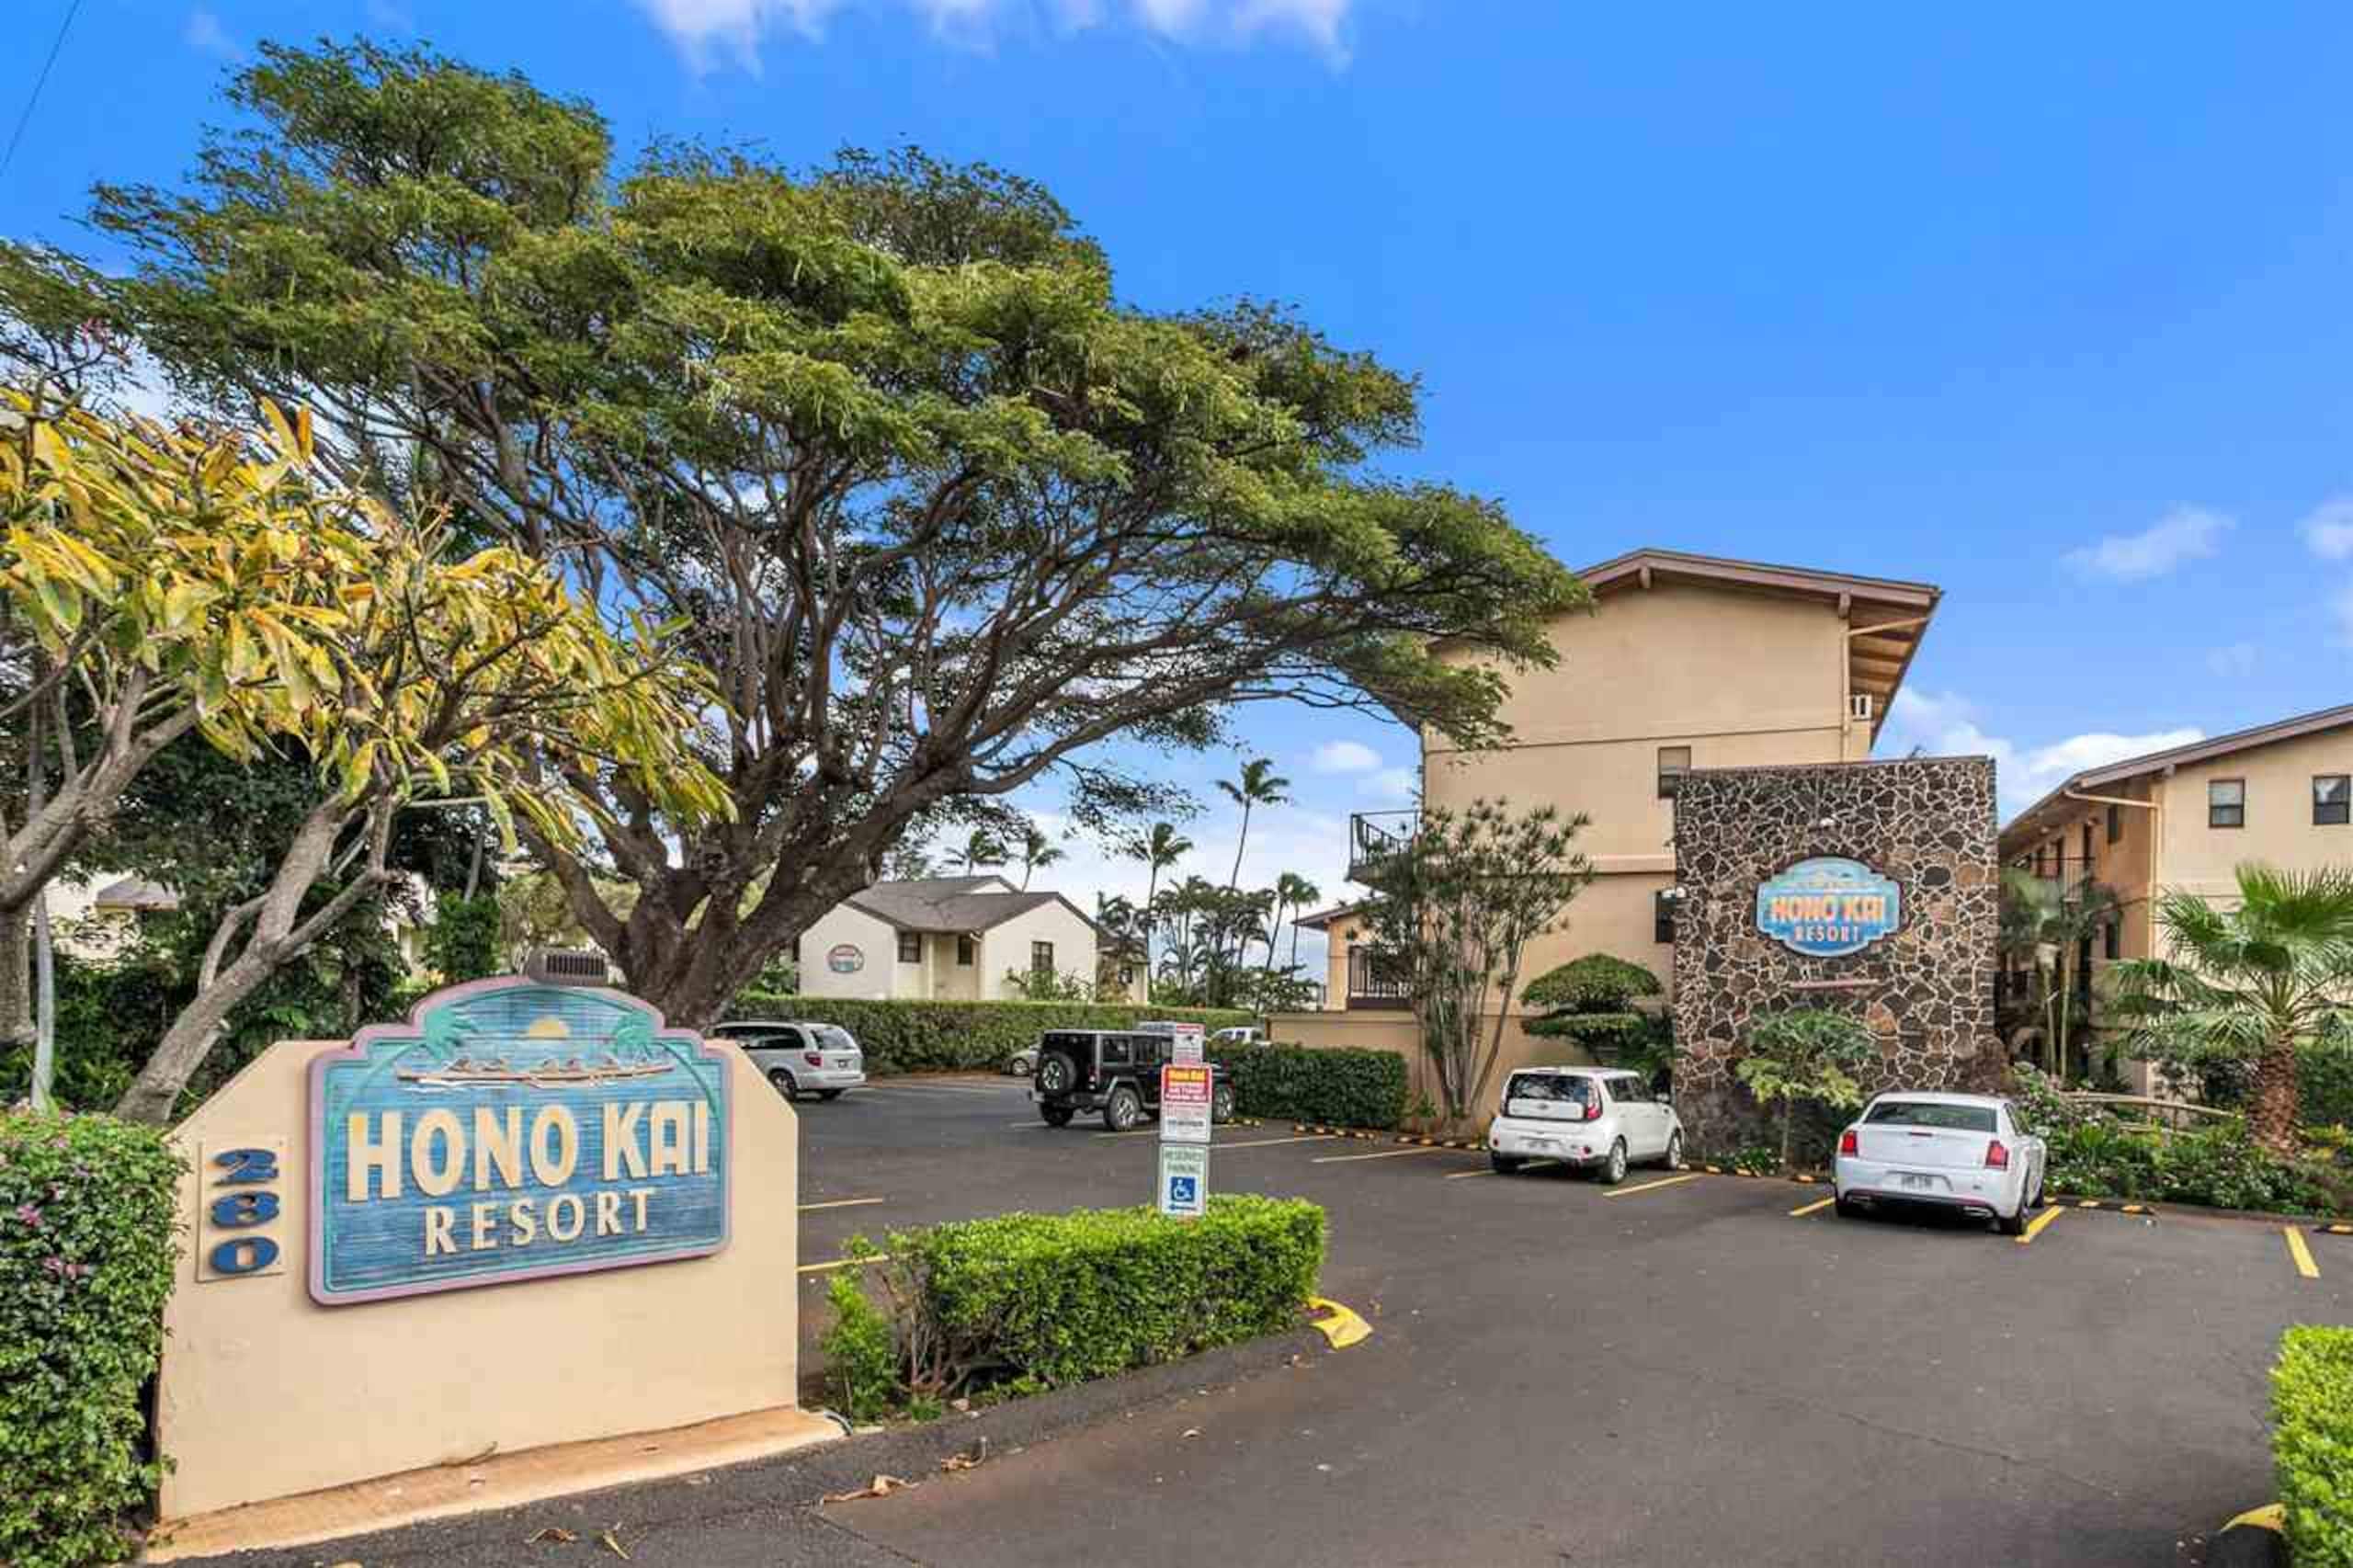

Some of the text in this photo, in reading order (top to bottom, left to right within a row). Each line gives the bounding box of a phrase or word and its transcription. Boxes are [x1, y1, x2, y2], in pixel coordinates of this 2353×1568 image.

[1771, 896, 1836, 921] HONO
[1793, 926, 1860, 942] RESORT
[346, 1100, 710, 1203] HONO KAI
[423, 1186, 656, 1256] RESORT
